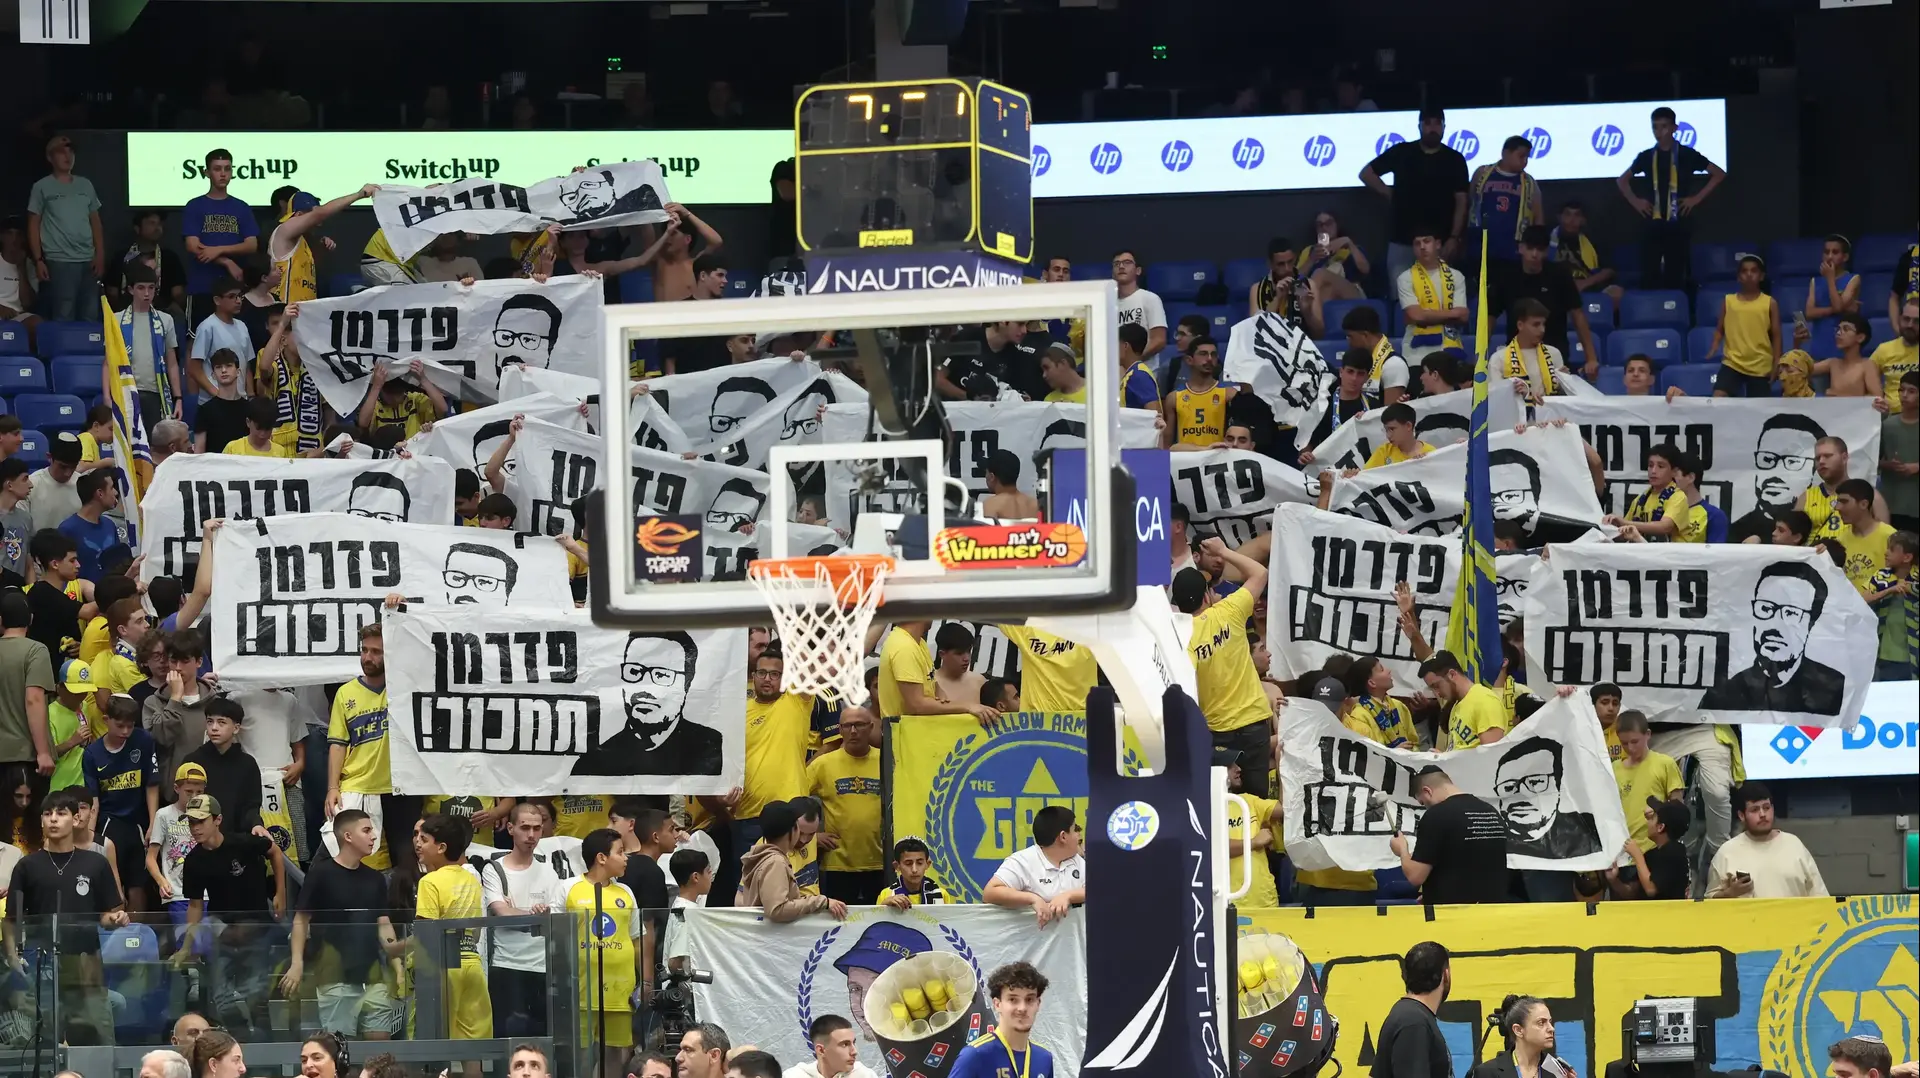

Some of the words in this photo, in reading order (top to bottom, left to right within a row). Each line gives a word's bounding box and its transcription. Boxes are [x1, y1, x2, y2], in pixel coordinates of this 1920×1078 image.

[1236, 138, 1262, 169] hp
[1307, 135, 1333, 166] hp
[1451, 130, 1477, 161] hp
[1595, 124, 1621, 156] hp
[182, 158, 298, 180] Stchup
[385, 157, 500, 180] Switchup
[1093, 142, 1119, 174] hp
[1164, 140, 1190, 172] hp
[835, 265, 972, 292] NAUTICA
[330, 306, 459, 352] פדרמן
[1196, 408, 1205, 425] 5
[949, 538, 1043, 561] Winner
[1008, 529, 1040, 545] ליגת
[1045, 540, 1068, 557] סל
[256, 541, 402, 600] פדרמן
[1312, 536, 1448, 593] פדרמן
[1563, 569, 1708, 627] פדרמן
[246, 602, 380, 654] מכור!
[431, 631, 578, 692] פדרמן
[1029, 638, 1048, 655] TEL
[1194, 643, 1213, 661] TEL
[1552, 631, 1717, 688] תמכור!
[354, 721, 377, 737] THE
[422, 695, 588, 753] תמכור!
[1051, 713, 1087, 732] ARM
[108, 772, 136, 788] QAAR
[969, 779, 995, 793] THE
[266, 794, 278, 812] FC
[1837, 895, 1912, 926] YELLOW
